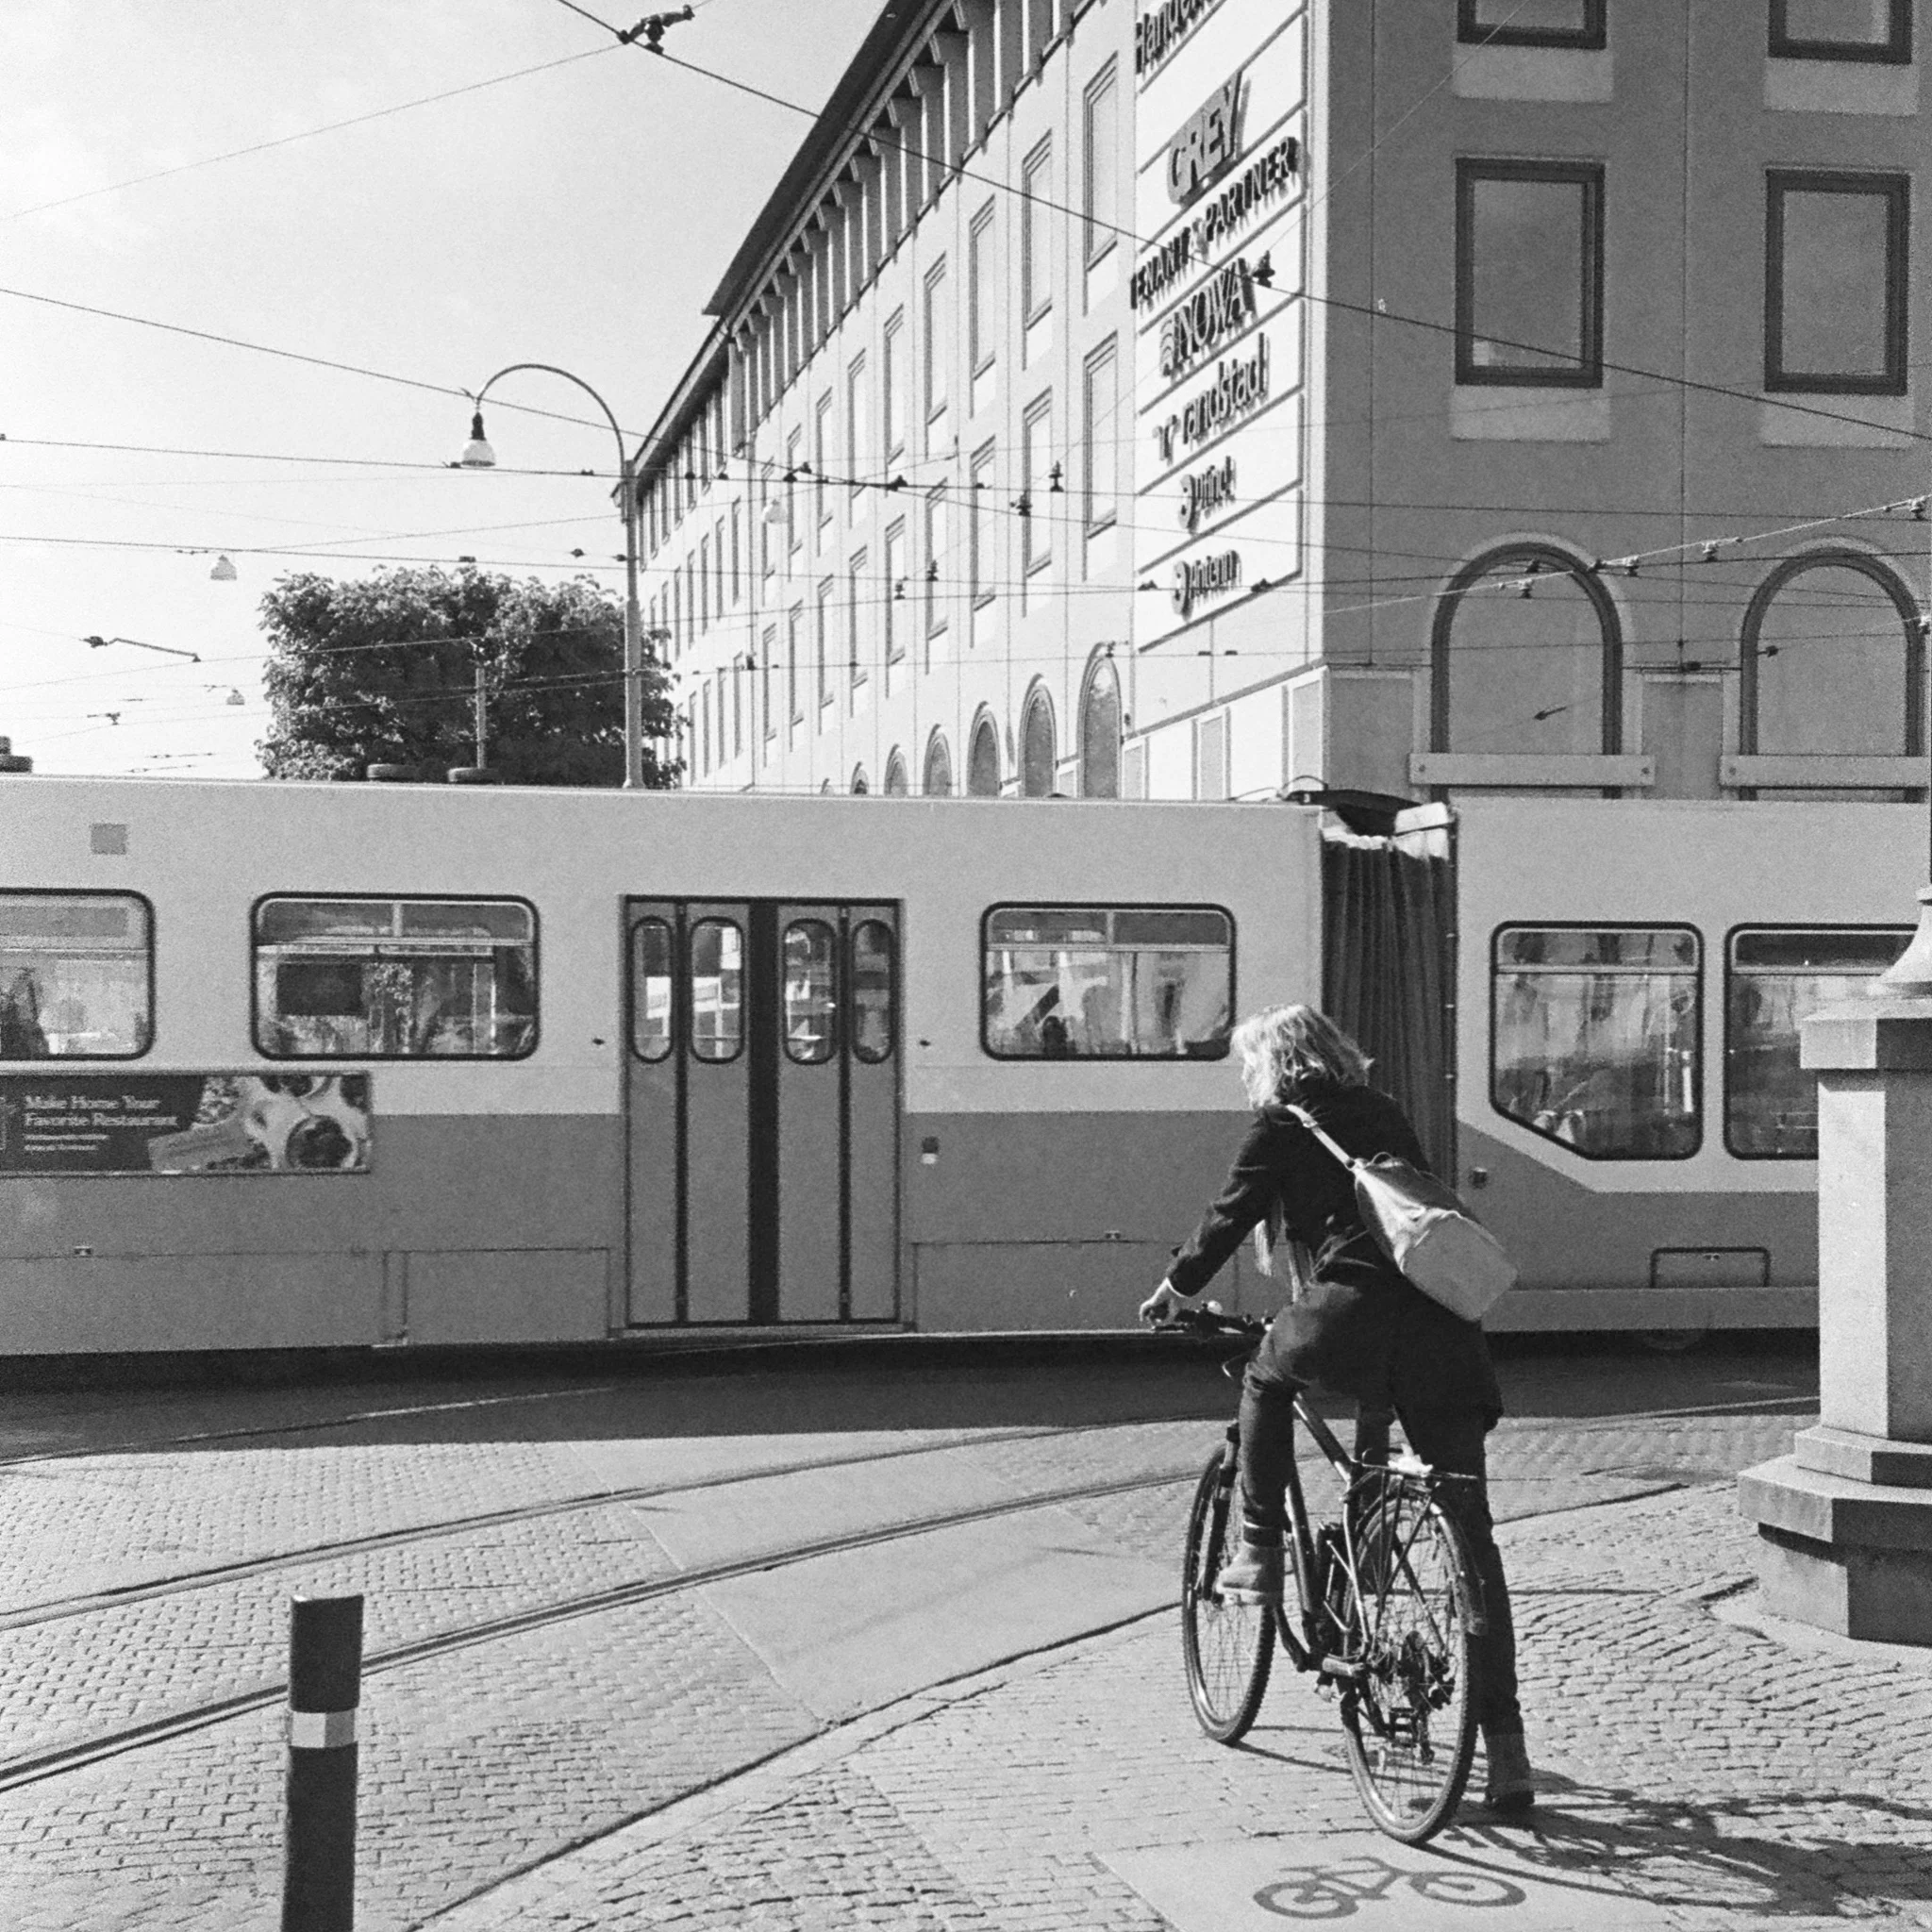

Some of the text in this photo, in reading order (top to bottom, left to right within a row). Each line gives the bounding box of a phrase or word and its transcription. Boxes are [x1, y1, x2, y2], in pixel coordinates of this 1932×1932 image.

[1169, 70, 1242, 202] GREY
[1206, 137, 1296, 242] PARTNER
[1182, 332, 1265, 445] randstad
[25, 1095, 161, 1109] Make Home Your
[25, 1111, 177, 1126] Favorite Restaurant
